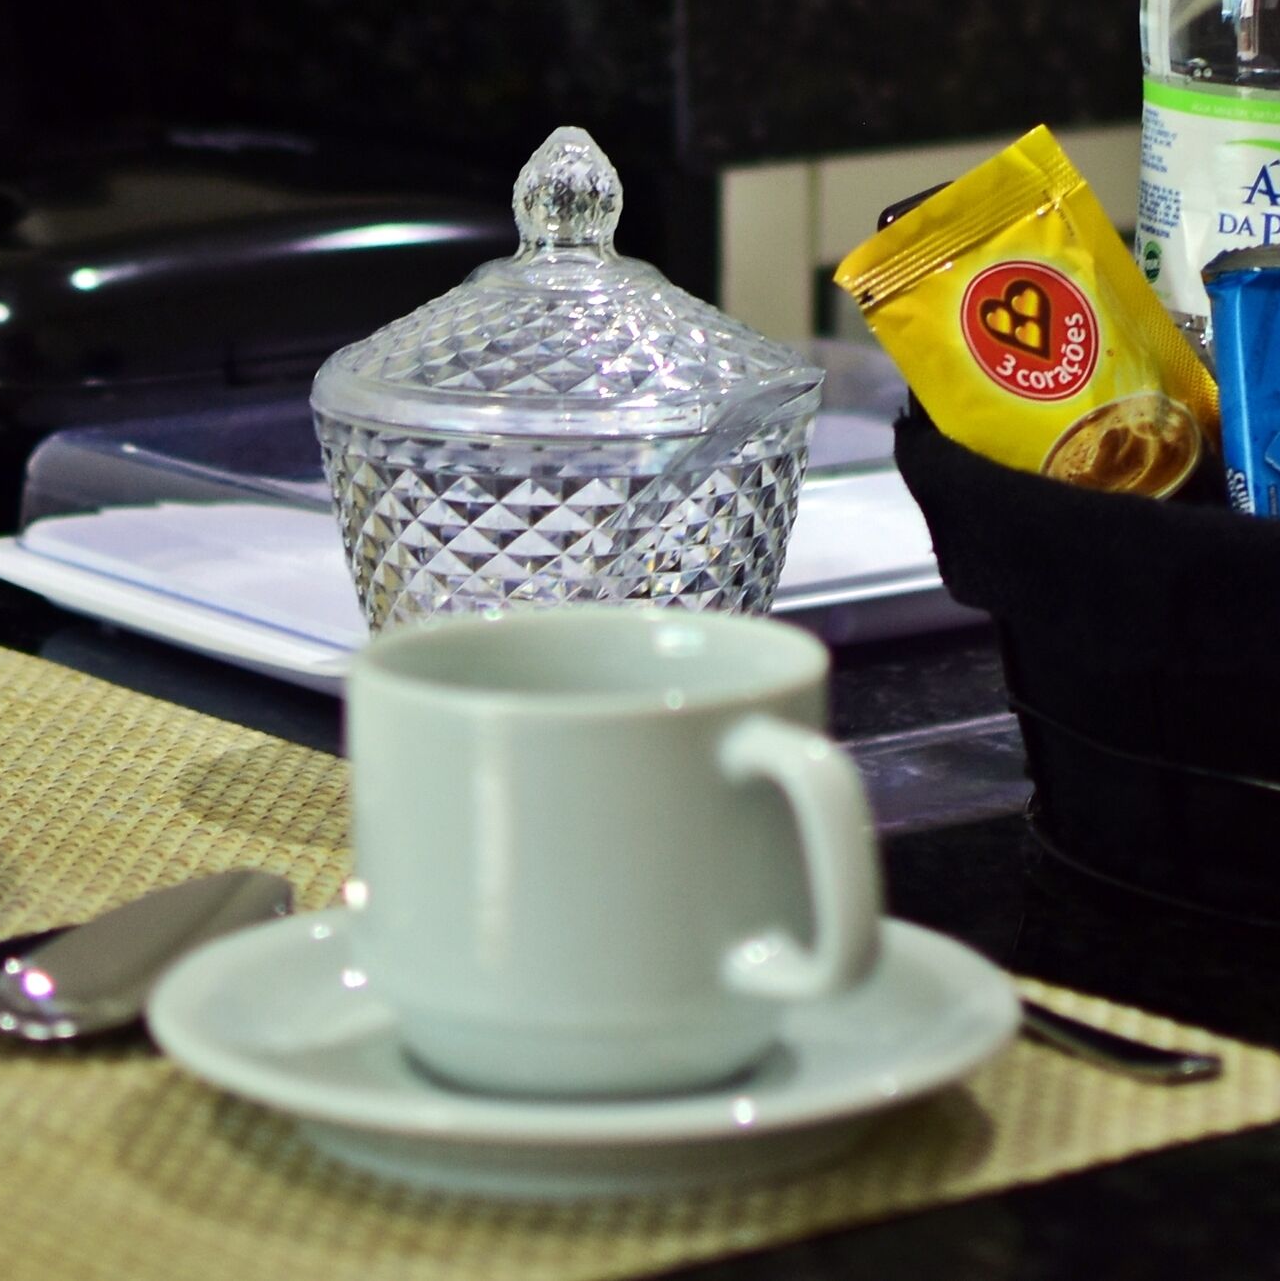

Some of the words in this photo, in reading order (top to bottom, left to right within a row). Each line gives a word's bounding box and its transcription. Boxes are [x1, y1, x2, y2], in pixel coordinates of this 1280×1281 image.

[1217, 213, 1257, 237] DA
[995, 353, 1017, 376] 3
[1016, 312, 1087, 389] corações
